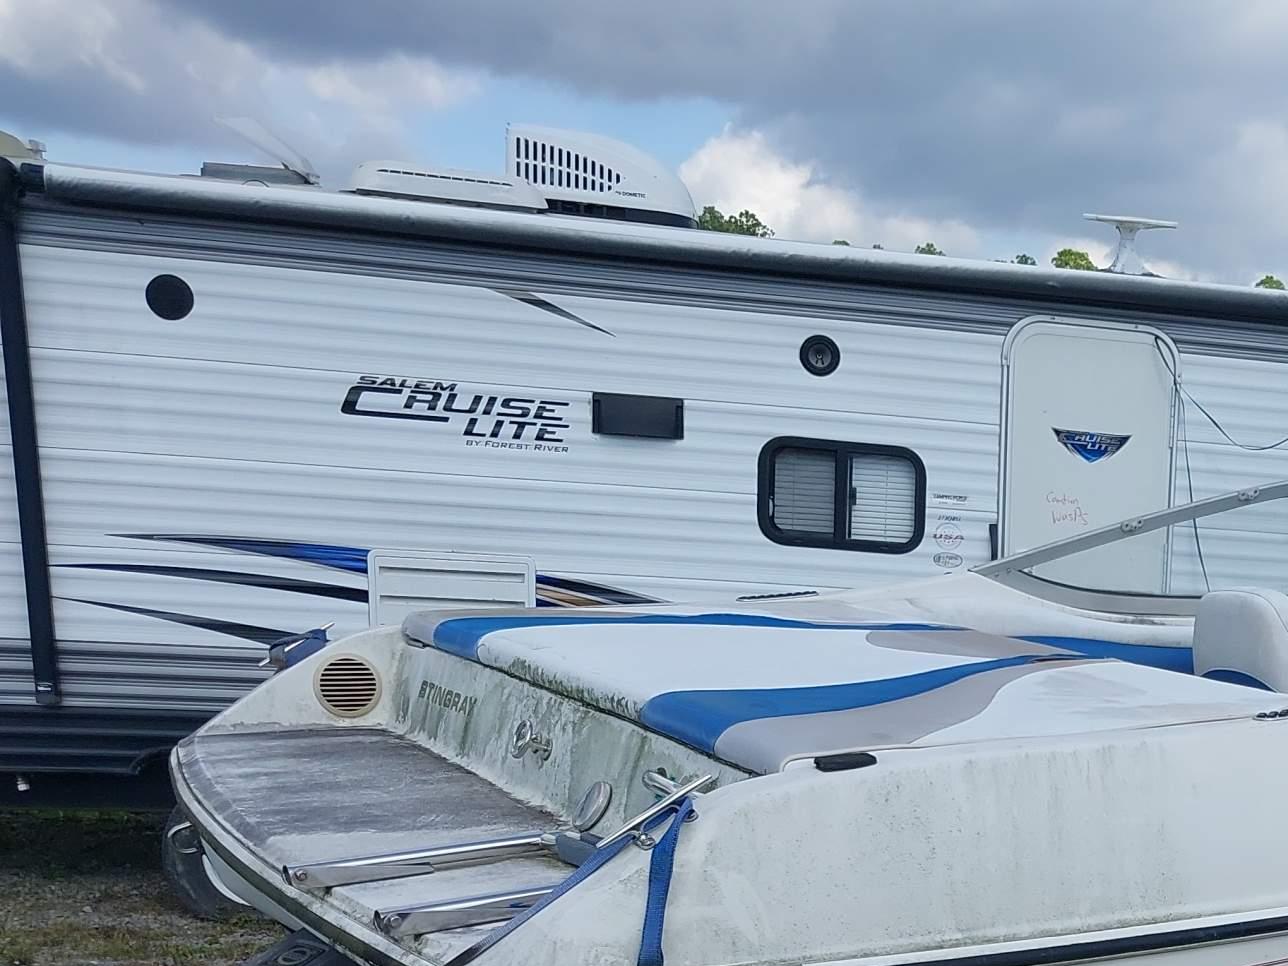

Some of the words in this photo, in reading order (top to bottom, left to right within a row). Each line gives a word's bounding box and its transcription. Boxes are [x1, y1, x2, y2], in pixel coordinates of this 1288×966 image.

[622, 191, 646, 199] DOMETIC
[356, 376, 458, 392] SALEM
[341, 385, 570, 422] CRUISE
[463, 418, 570, 443] LITE
[485, 441, 531, 450] FOREST
[534, 444, 569, 453] RIVER
[1059, 433, 1121, 445] CRUISE
[418, 680, 478, 717] STINGRAY
